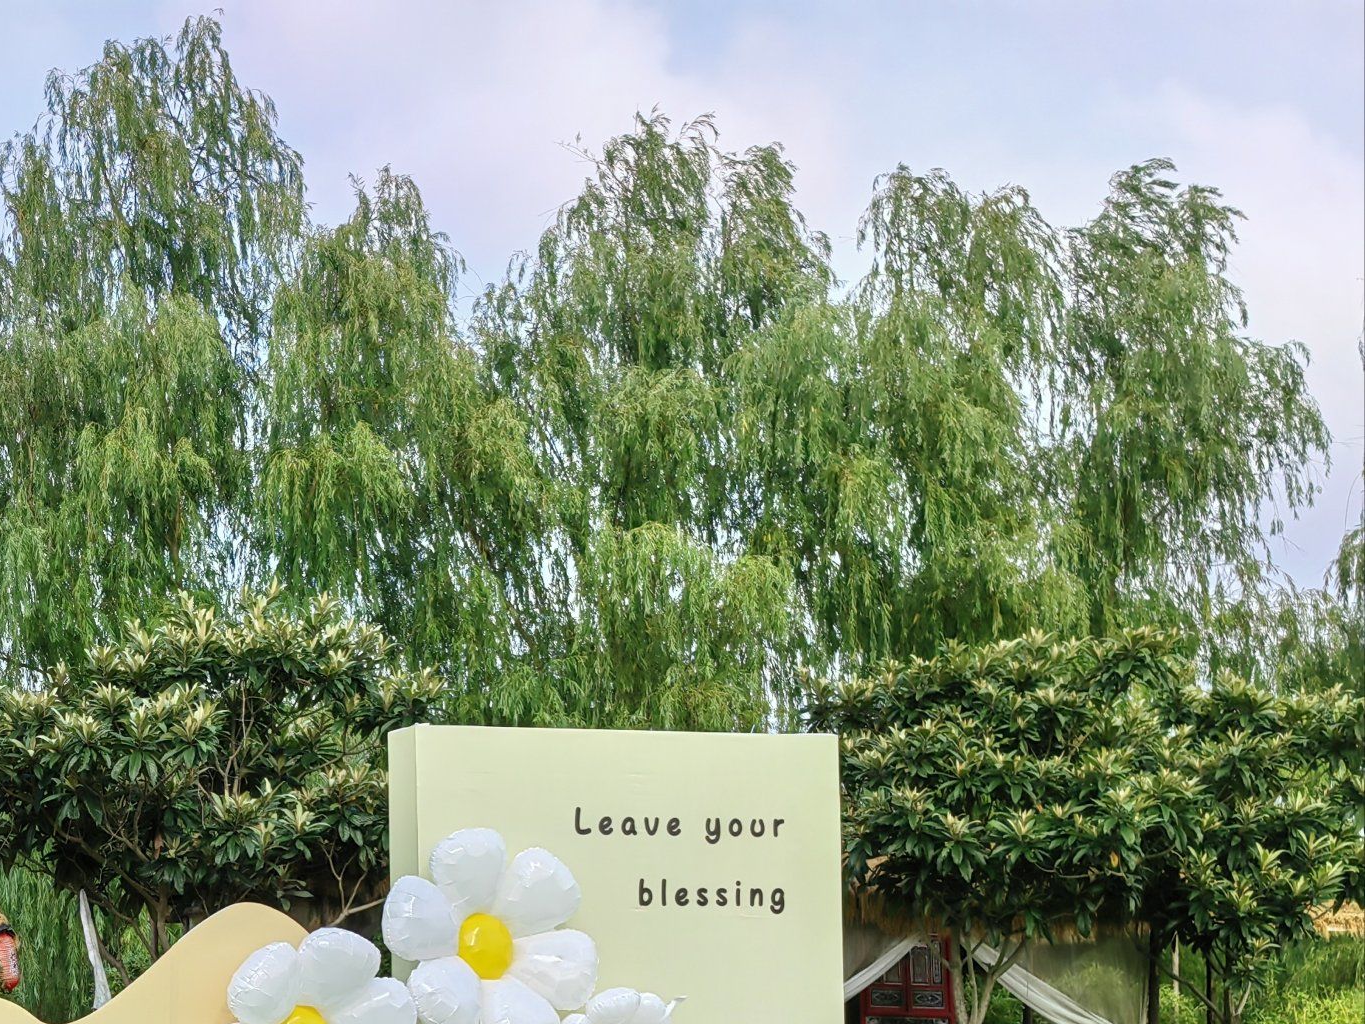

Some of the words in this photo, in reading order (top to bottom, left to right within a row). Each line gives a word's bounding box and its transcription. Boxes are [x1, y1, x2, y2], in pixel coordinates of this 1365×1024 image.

[574, 807, 682, 836] Leave
[705, 817, 786, 844] your
[638, 878, 786, 915] blessing
